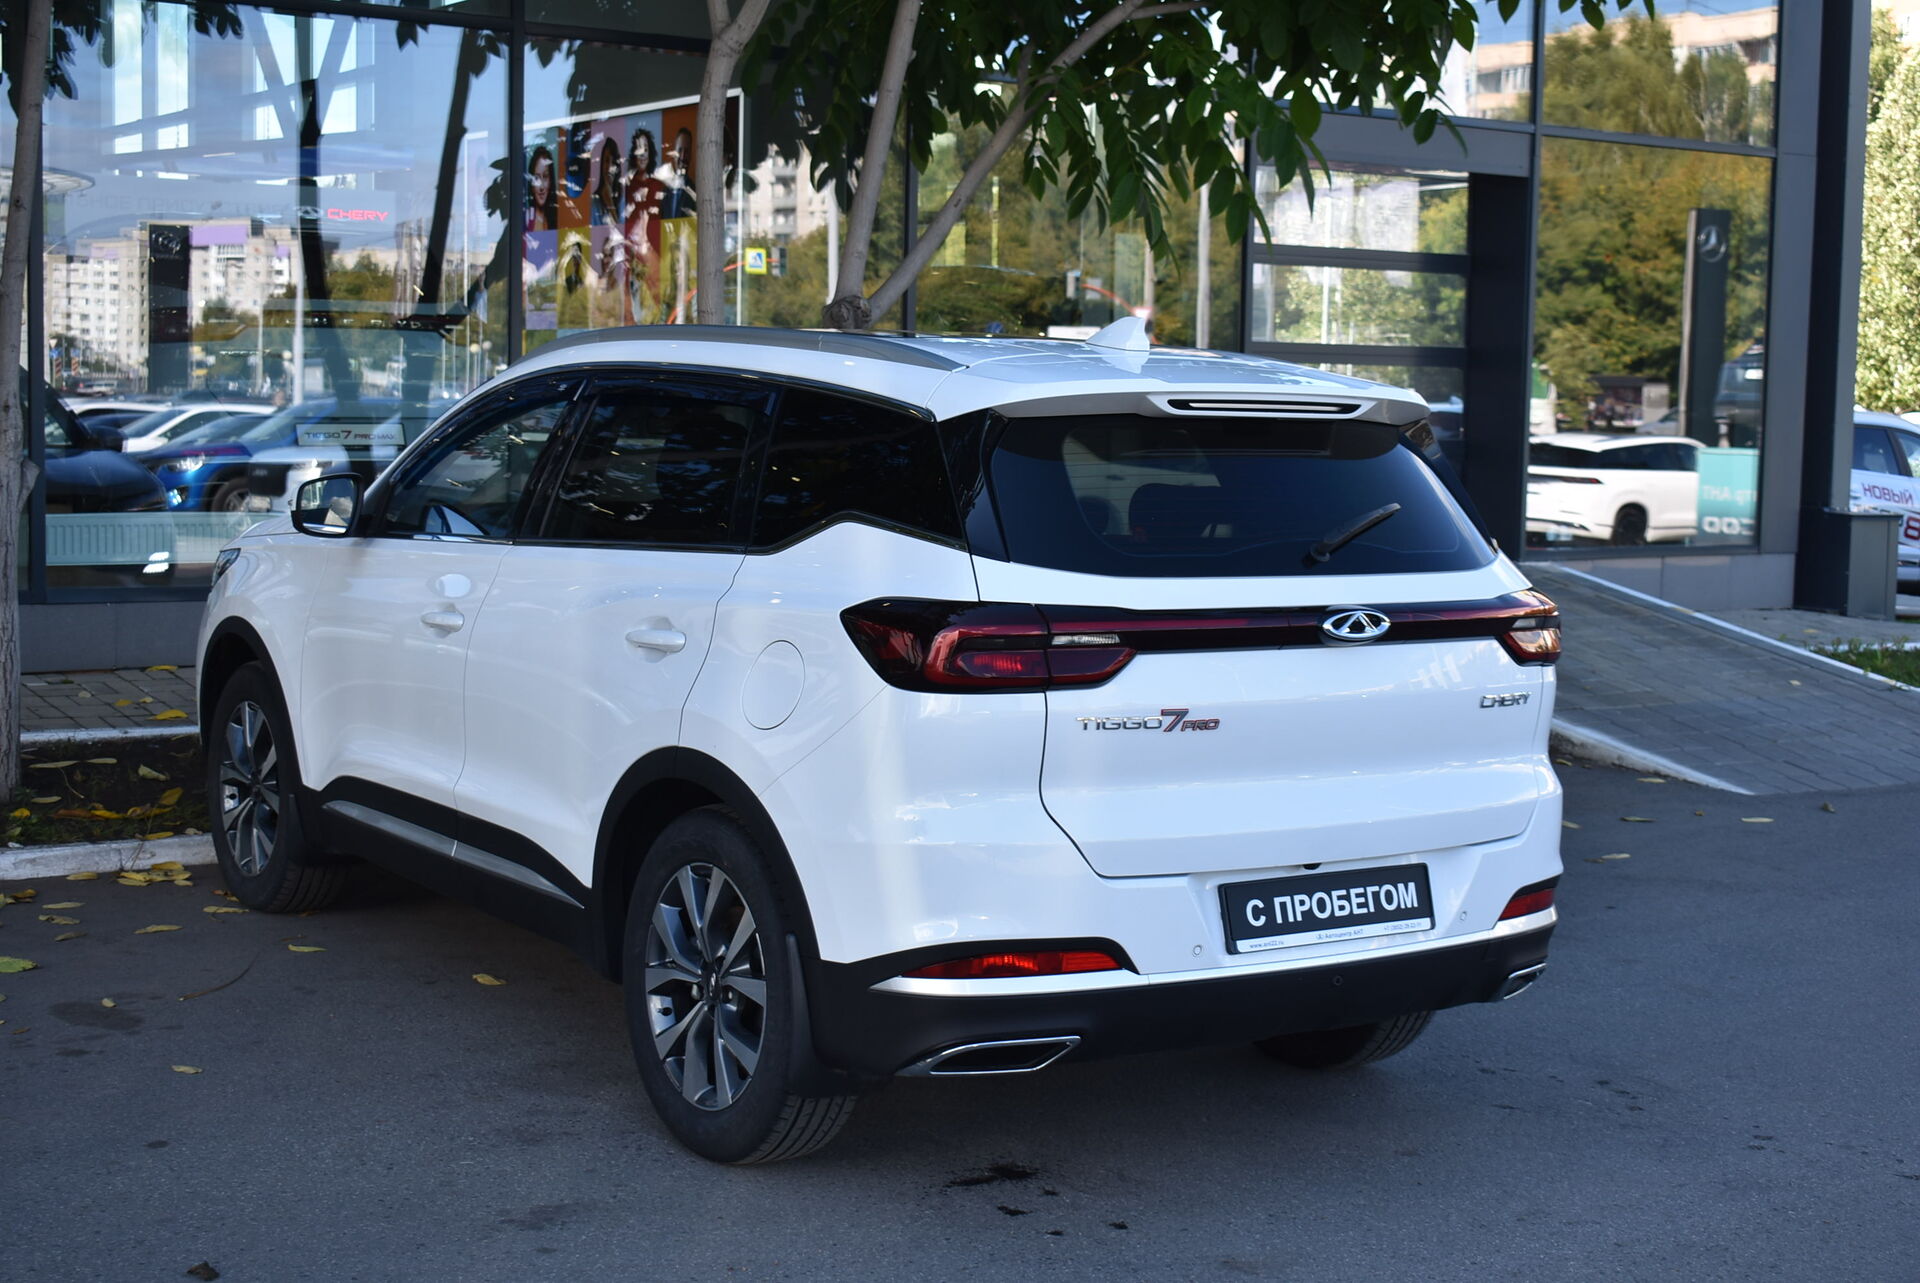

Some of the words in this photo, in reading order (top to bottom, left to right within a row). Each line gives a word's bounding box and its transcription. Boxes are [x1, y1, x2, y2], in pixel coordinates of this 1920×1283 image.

[326, 207, 389, 222] CHERY
[1860, 482, 1914, 506] НОВЫЙ
[1479, 691, 1532, 709] CHERY
[1246, 899, 1267, 927] С
[1273, 881, 1419, 924] ПРОБЕГОМ
